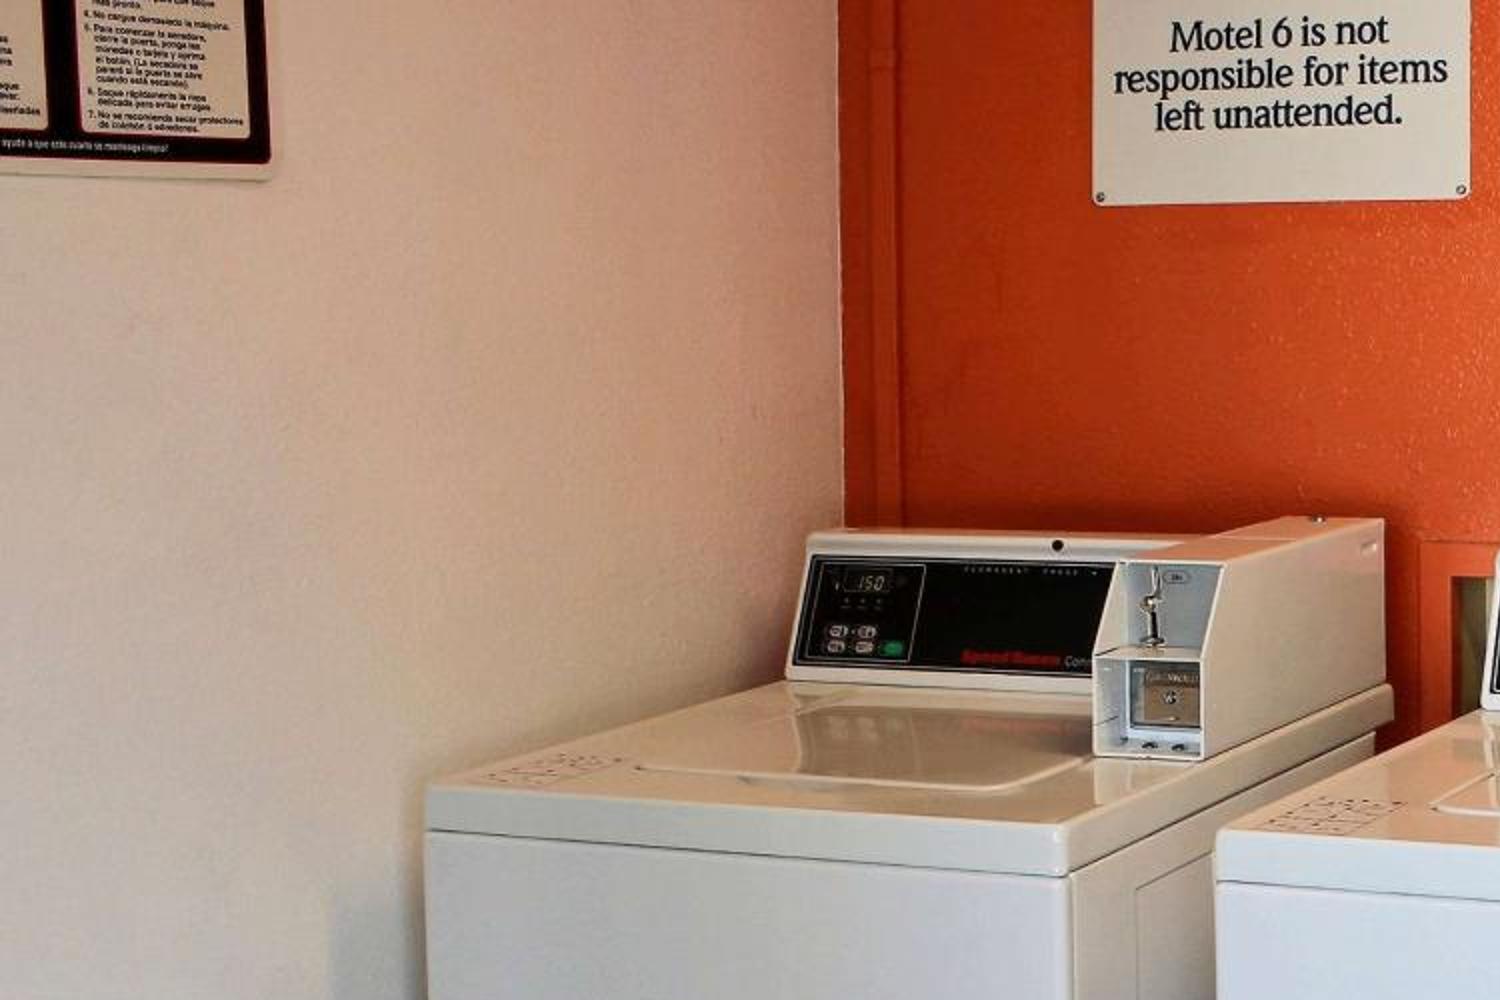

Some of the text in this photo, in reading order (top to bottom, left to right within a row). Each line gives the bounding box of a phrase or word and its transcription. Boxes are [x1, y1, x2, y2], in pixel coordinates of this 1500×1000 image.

[1169, 15, 1390, 53] Motel 6 is not
[1114, 54, 1448, 99] responsible for items
[1155, 96, 1402, 130] left unattended.
[858, 575, 885, 591] 150
